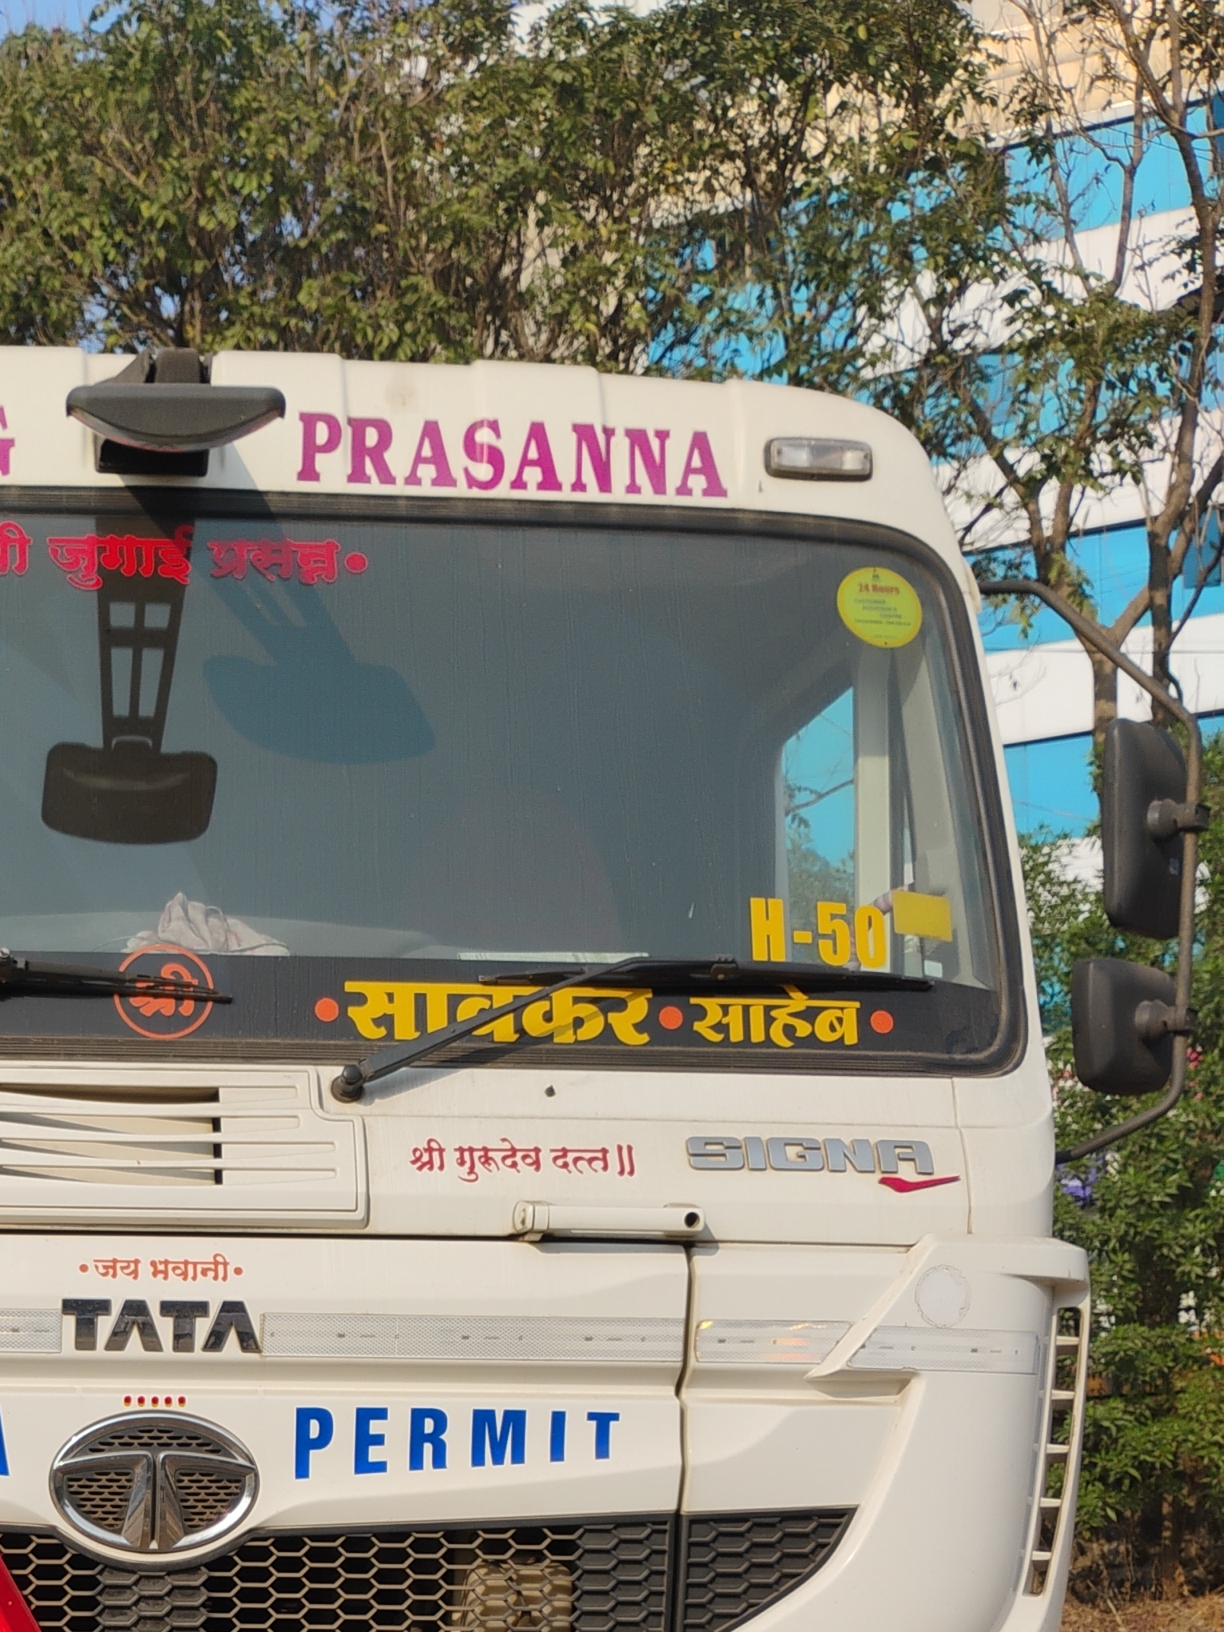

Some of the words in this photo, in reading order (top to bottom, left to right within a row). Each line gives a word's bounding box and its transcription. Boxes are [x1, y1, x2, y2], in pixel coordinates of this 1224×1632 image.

[297, 411, 728, 498] PRASANNA
[208, 538, 341, 585] प्रसन्न
[750, 897, 888, 969] H-50
[688, 984, 862, 1048] साहेब
[409, 1137, 446, 1172] श्री
[687, 1136, 936, 1175] SIGNA
[93, 1257, 141, 1281] जय
[149, 1253, 230, 1283] भवानी
[61, 1298, 263, 1354] TATA
[295, 1406, 621, 1479] PERMIT
